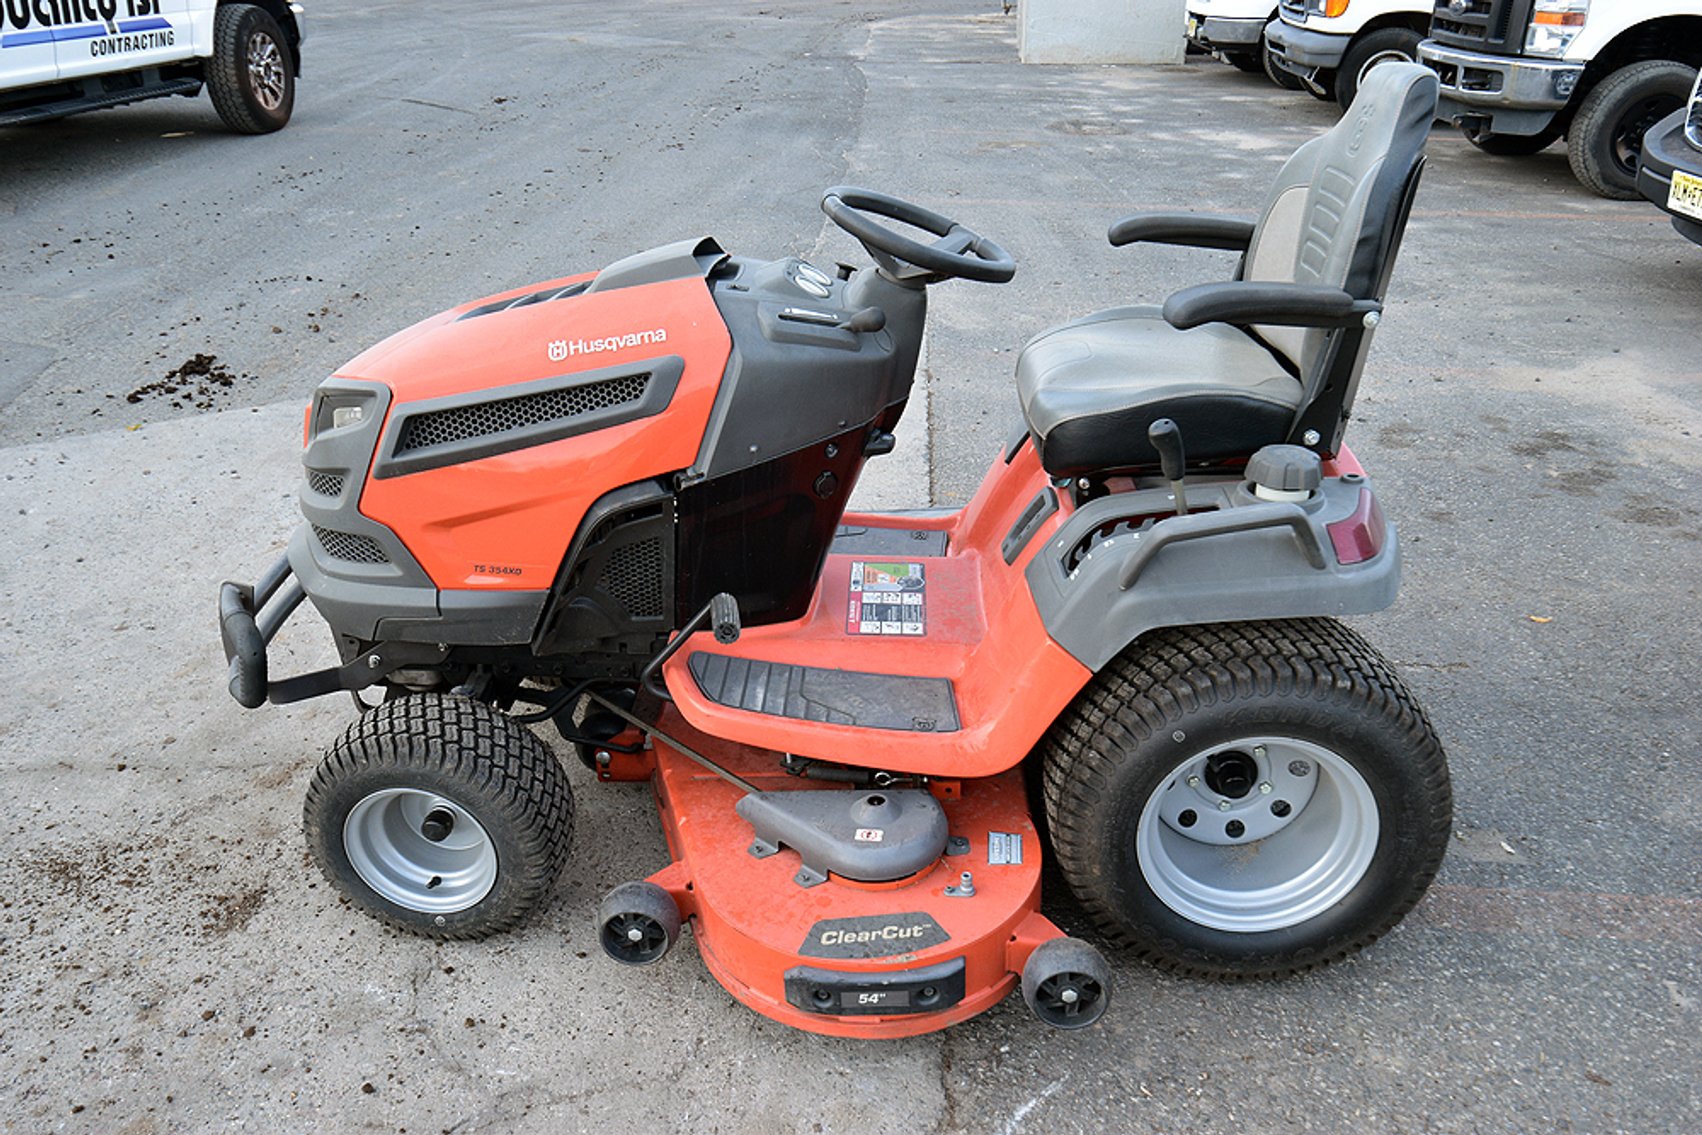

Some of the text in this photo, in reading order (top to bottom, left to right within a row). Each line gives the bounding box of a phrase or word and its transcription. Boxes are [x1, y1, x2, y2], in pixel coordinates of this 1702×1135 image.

[90, 31, 175, 57] CONTRACTING
[569, 328, 667, 356] Husqvarna
[474, 564, 487, 573] TS
